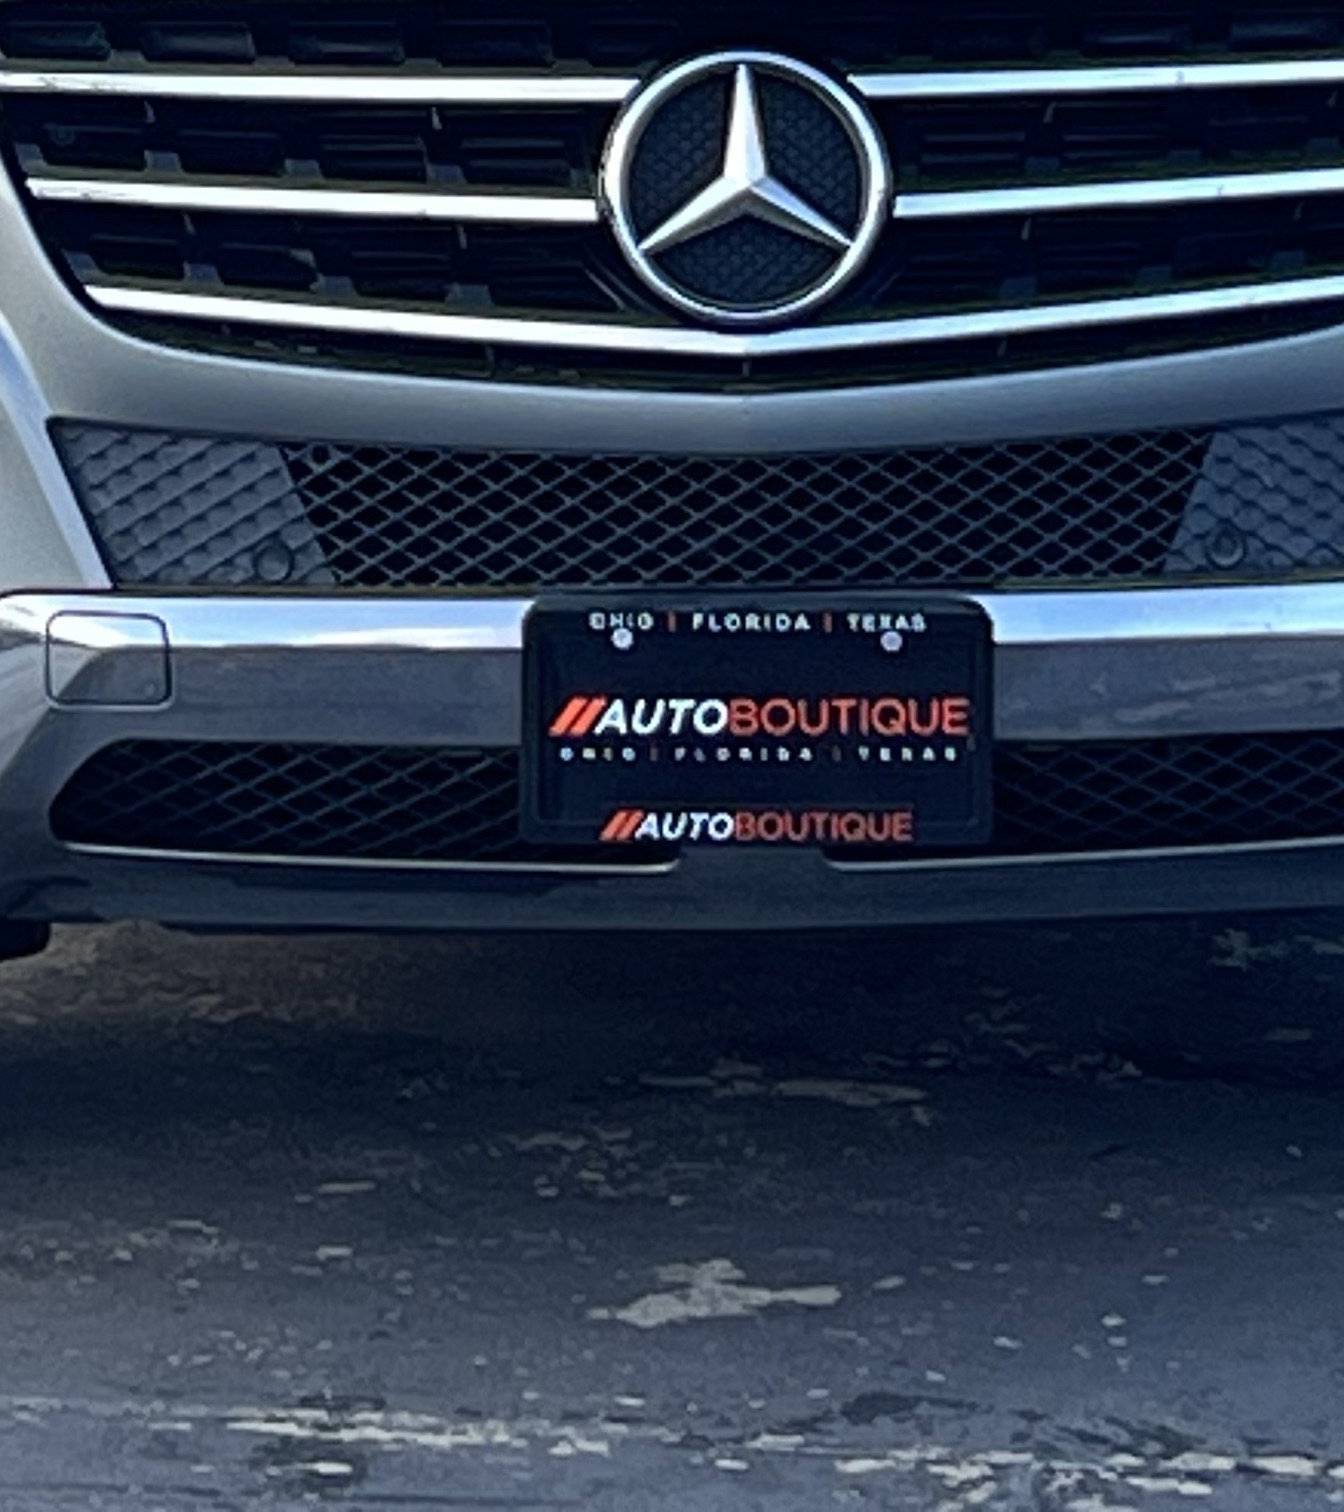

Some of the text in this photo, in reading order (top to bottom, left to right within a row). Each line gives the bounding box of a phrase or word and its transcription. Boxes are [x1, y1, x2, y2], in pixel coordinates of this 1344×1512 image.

[589, 612, 928, 632] OHIO FLORIDA TEXAS
[674, 747, 813, 762] FLORIDA
